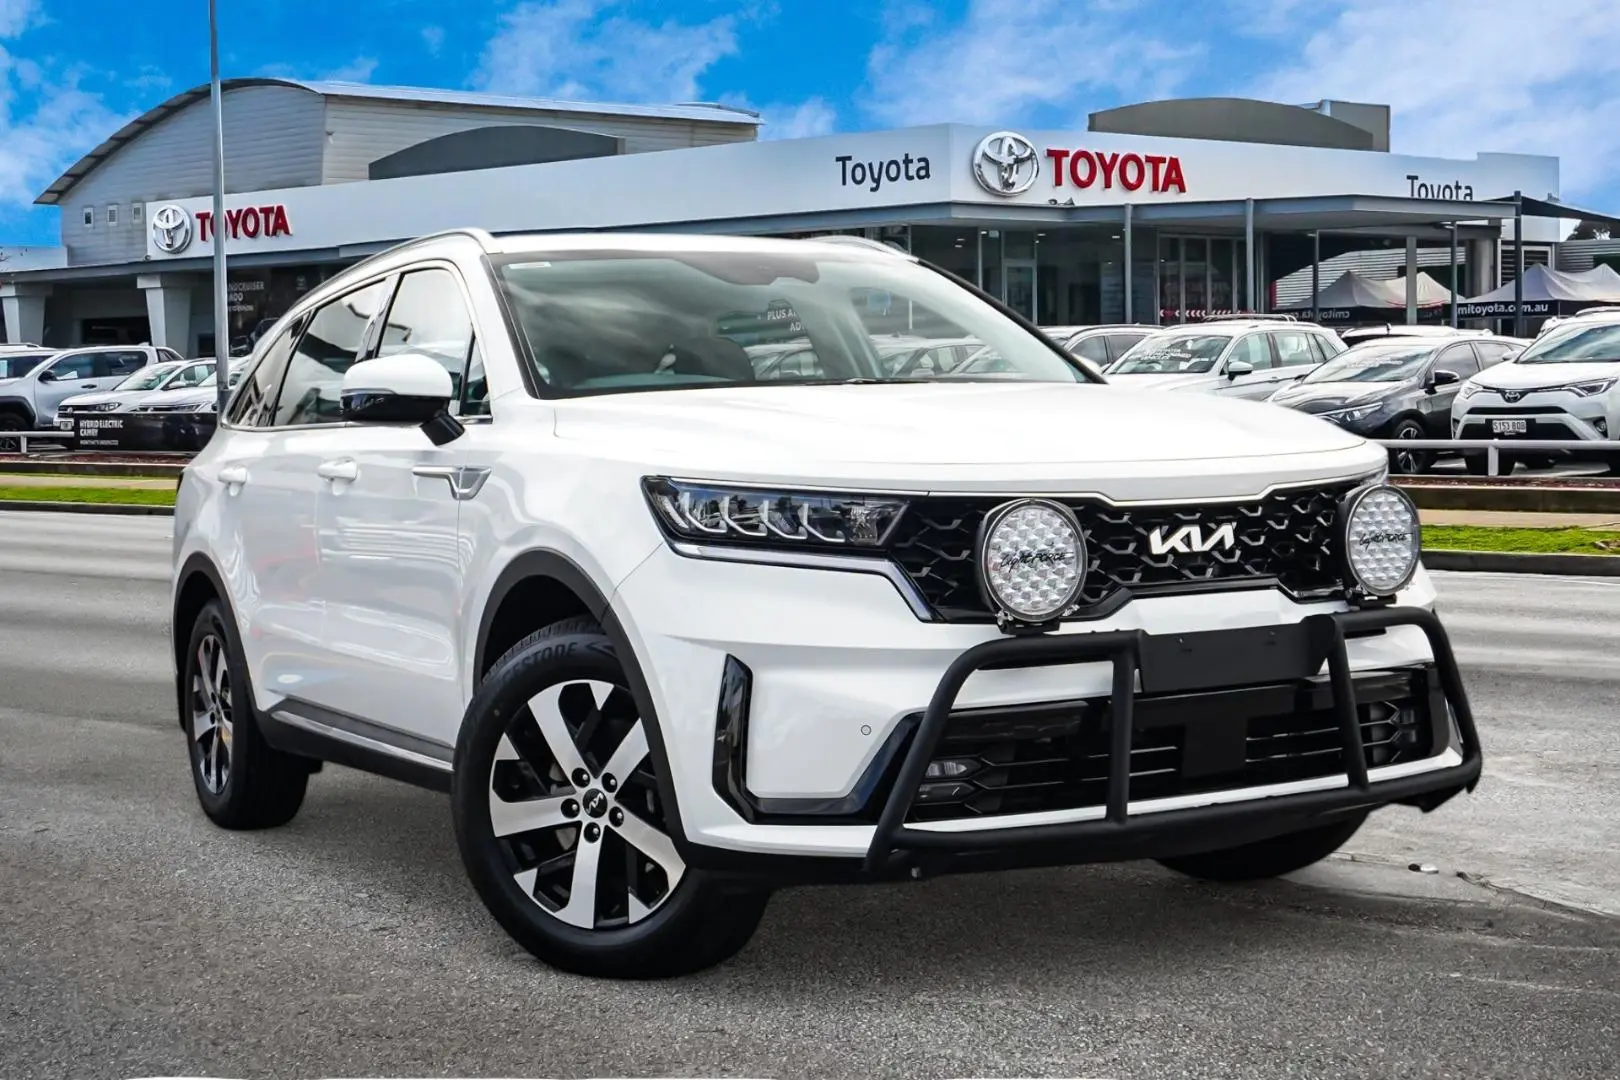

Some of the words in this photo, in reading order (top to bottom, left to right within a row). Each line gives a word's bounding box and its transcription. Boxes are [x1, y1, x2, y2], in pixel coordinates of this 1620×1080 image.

[836, 152, 931, 192] Toyota
[1046, 148, 1187, 194] TOYOTA
[1148, 522, 1237, 555] KIA
